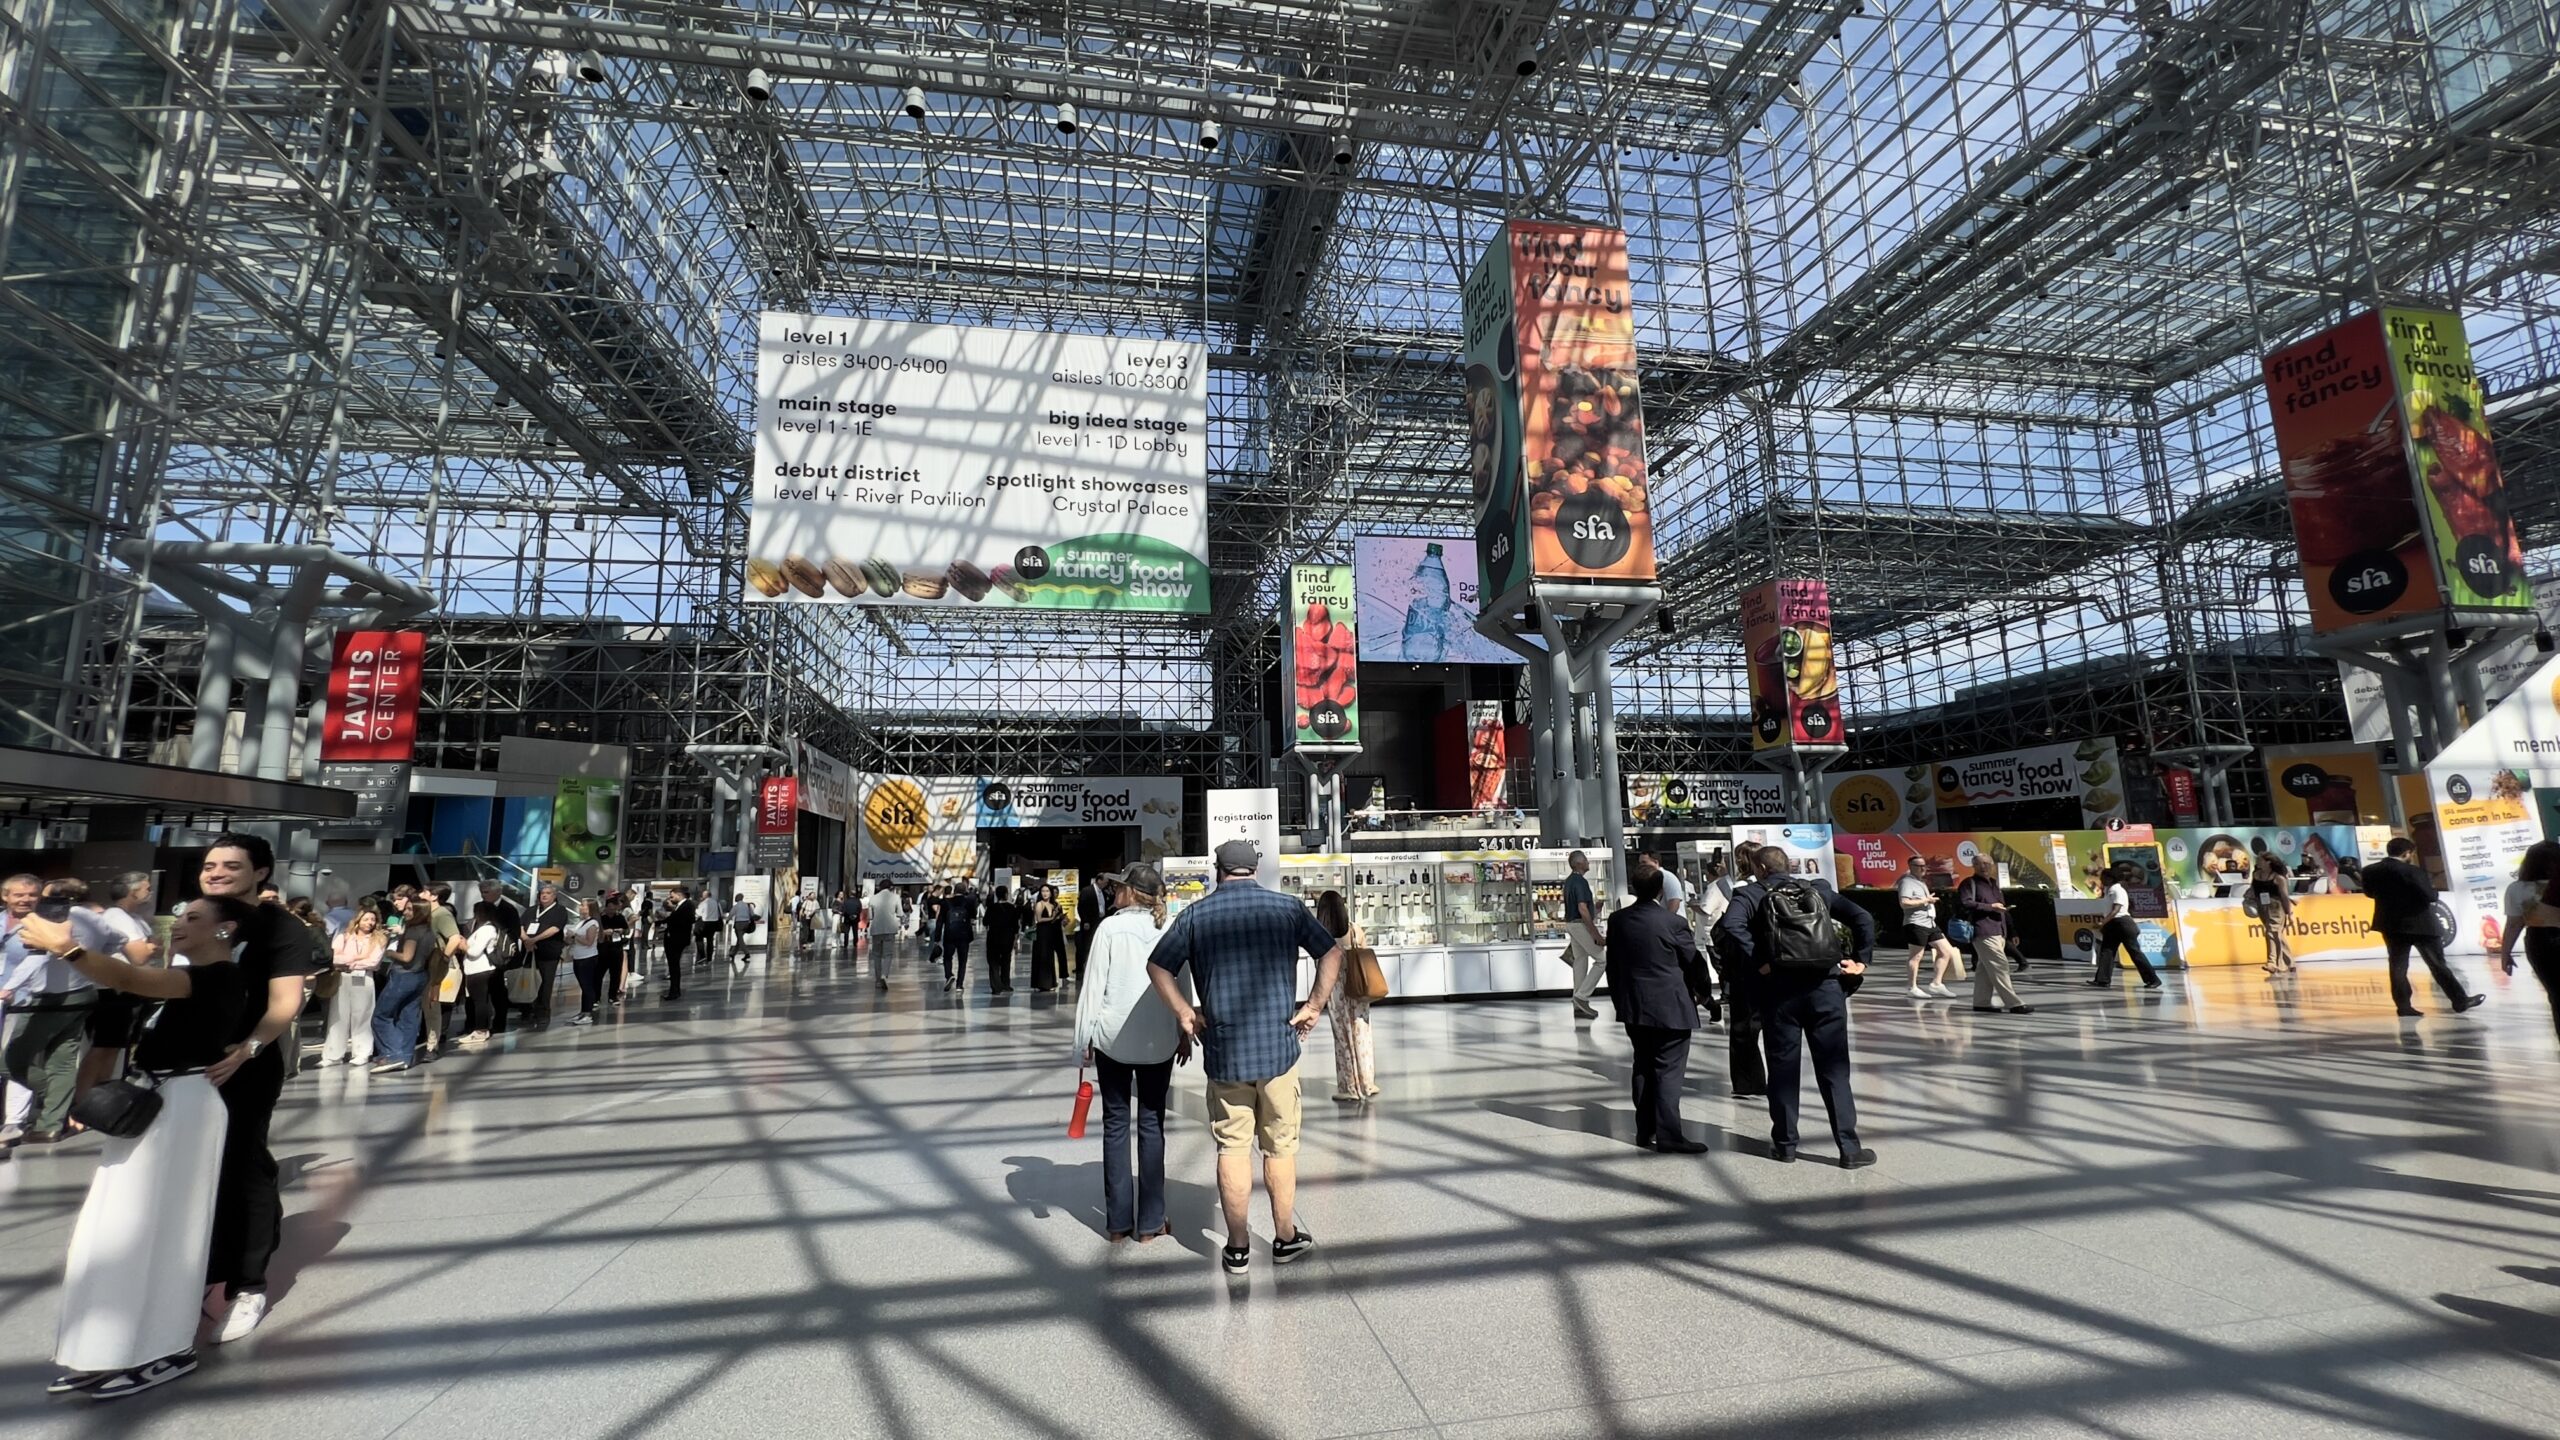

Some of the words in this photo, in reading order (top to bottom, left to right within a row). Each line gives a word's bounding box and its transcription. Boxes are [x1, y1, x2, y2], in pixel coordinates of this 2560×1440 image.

[1519, 231, 1583, 261] find
[1544, 263, 1597, 283] your
[1465, 263, 1489, 317] find
[1529, 275, 1622, 313] fancy
[1475, 281, 1496, 325] your
[1469, 290, 1507, 352] fancy
[2391, 317, 2436, 341] find
[784, 328, 832, 345] level
[839, 332, 847, 346] 1
[2411, 342, 2448, 358] your
[782, 351, 837, 368] aisles
[843, 354, 947, 375] 3400-6400
[1127, 353, 1171, 369] level
[1177, 355, 1188, 369] 3
[2271, 340, 2336, 383] find
[2404, 355, 2472, 383] fancy
[1052, 370, 1102, 386] aisles
[1108, 372, 1188, 390] 100-3300
[2296, 356, 2352, 391] your
[2284, 365, 2381, 414] fancy
[779, 398, 831, 412] main
[838, 400, 897, 417] stage
[777, 418, 822, 434] level
[828, 420, 834, 434] 1
[854, 421, 872, 436] 1E
[1049, 411, 1080, 431] big
[1086, 413, 1127, 429] idea
[1133, 416, 1188, 433] stage
[1037, 432, 1077, 447] level
[1084, 434, 1090, 448] 1
[1108, 435, 1127, 449] 1D
[1133, 436, 1188, 457] Lobby
[775, 463, 838, 480] debut
[845, 465, 920, 482] district
[986, 473, 1075, 492] spotlight
[1081, 476, 1188, 495] showcases
[774, 485, 819, 501] level
[825, 487, 837, 502] 4
[856, 488, 902, 504] River
[911, 489, 986, 509] Pavilion
[1053, 496, 1121, 516] Crystal
[1128, 500, 1188, 517] Palace
[1573, 514, 1616, 541] sfa
[1067, 550, 1133, 563] summer
[1491, 533, 1509, 564] sfa
[1023, 556, 1043, 567] sfa
[1055, 557, 1124, 584] fancy
[1129, 561, 1183, 580] food
[2468, 554, 2499, 575] sfa
[1297, 570, 1329, 583] find
[2347, 568, 2391, 593] sfa
[1130, 579, 1192, 597] show
[1309, 585, 1336, 594] your
[1781, 585, 1808, 597] find
[1301, 592, 1348, 609] fancy
[1792, 598, 1814, 607] your
[1746, 611, 1775, 629] fancy
[1786, 605, 1826, 620] fancy
[342, 650, 374, 740] JAVITS
[375, 650, 401, 741] CENTER
[1317, 712, 1340, 724] sfa
[1763, 718, 1776, 731] sfa
[1807, 714, 1826, 726] sfa
[1962, 769, 2014, 788] fancy
[2018, 758, 2063, 779] food
[1969, 757, 2018, 772] summer
[1027, 783, 1085, 792] summer
[1700, 779, 1744, 788] summer
[2020, 778, 2072, 796] show
[2292, 773, 2320, 786] sfa
[989, 791, 1006, 800] sfa
[1015, 790, 1077, 812] fancy
[1082, 789, 1130, 807] food
[1692, 786, 1739, 805] fancy
[1743, 785, 1780, 801] food
[1847, 793, 1885, 813] sfa
[766, 785, 778, 826] JAVITS
[780, 785, 789, 826] CENTER
[881, 802, 915, 825] sfa
[1082, 806, 1137, 822] show
[1744, 801, 1786, 814] show
[1214, 812, 1272, 823] registration
[2449, 816, 2475, 826] come
[2477, 815, 2488, 823] on
[2492, 812, 2500, 820] in
[1479, 837, 1517, 850] 3411
[1857, 839, 1881, 851] find
[1962, 849, 1975, 857] sfa
[1861, 858, 1896, 871] fancy
[1866, 851, 1886, 859] your
[2462, 860, 2494, 870] benefits
[863, 871, 928, 879] #fancyfoodshow
[2249, 912, 2372, 938] mbership
